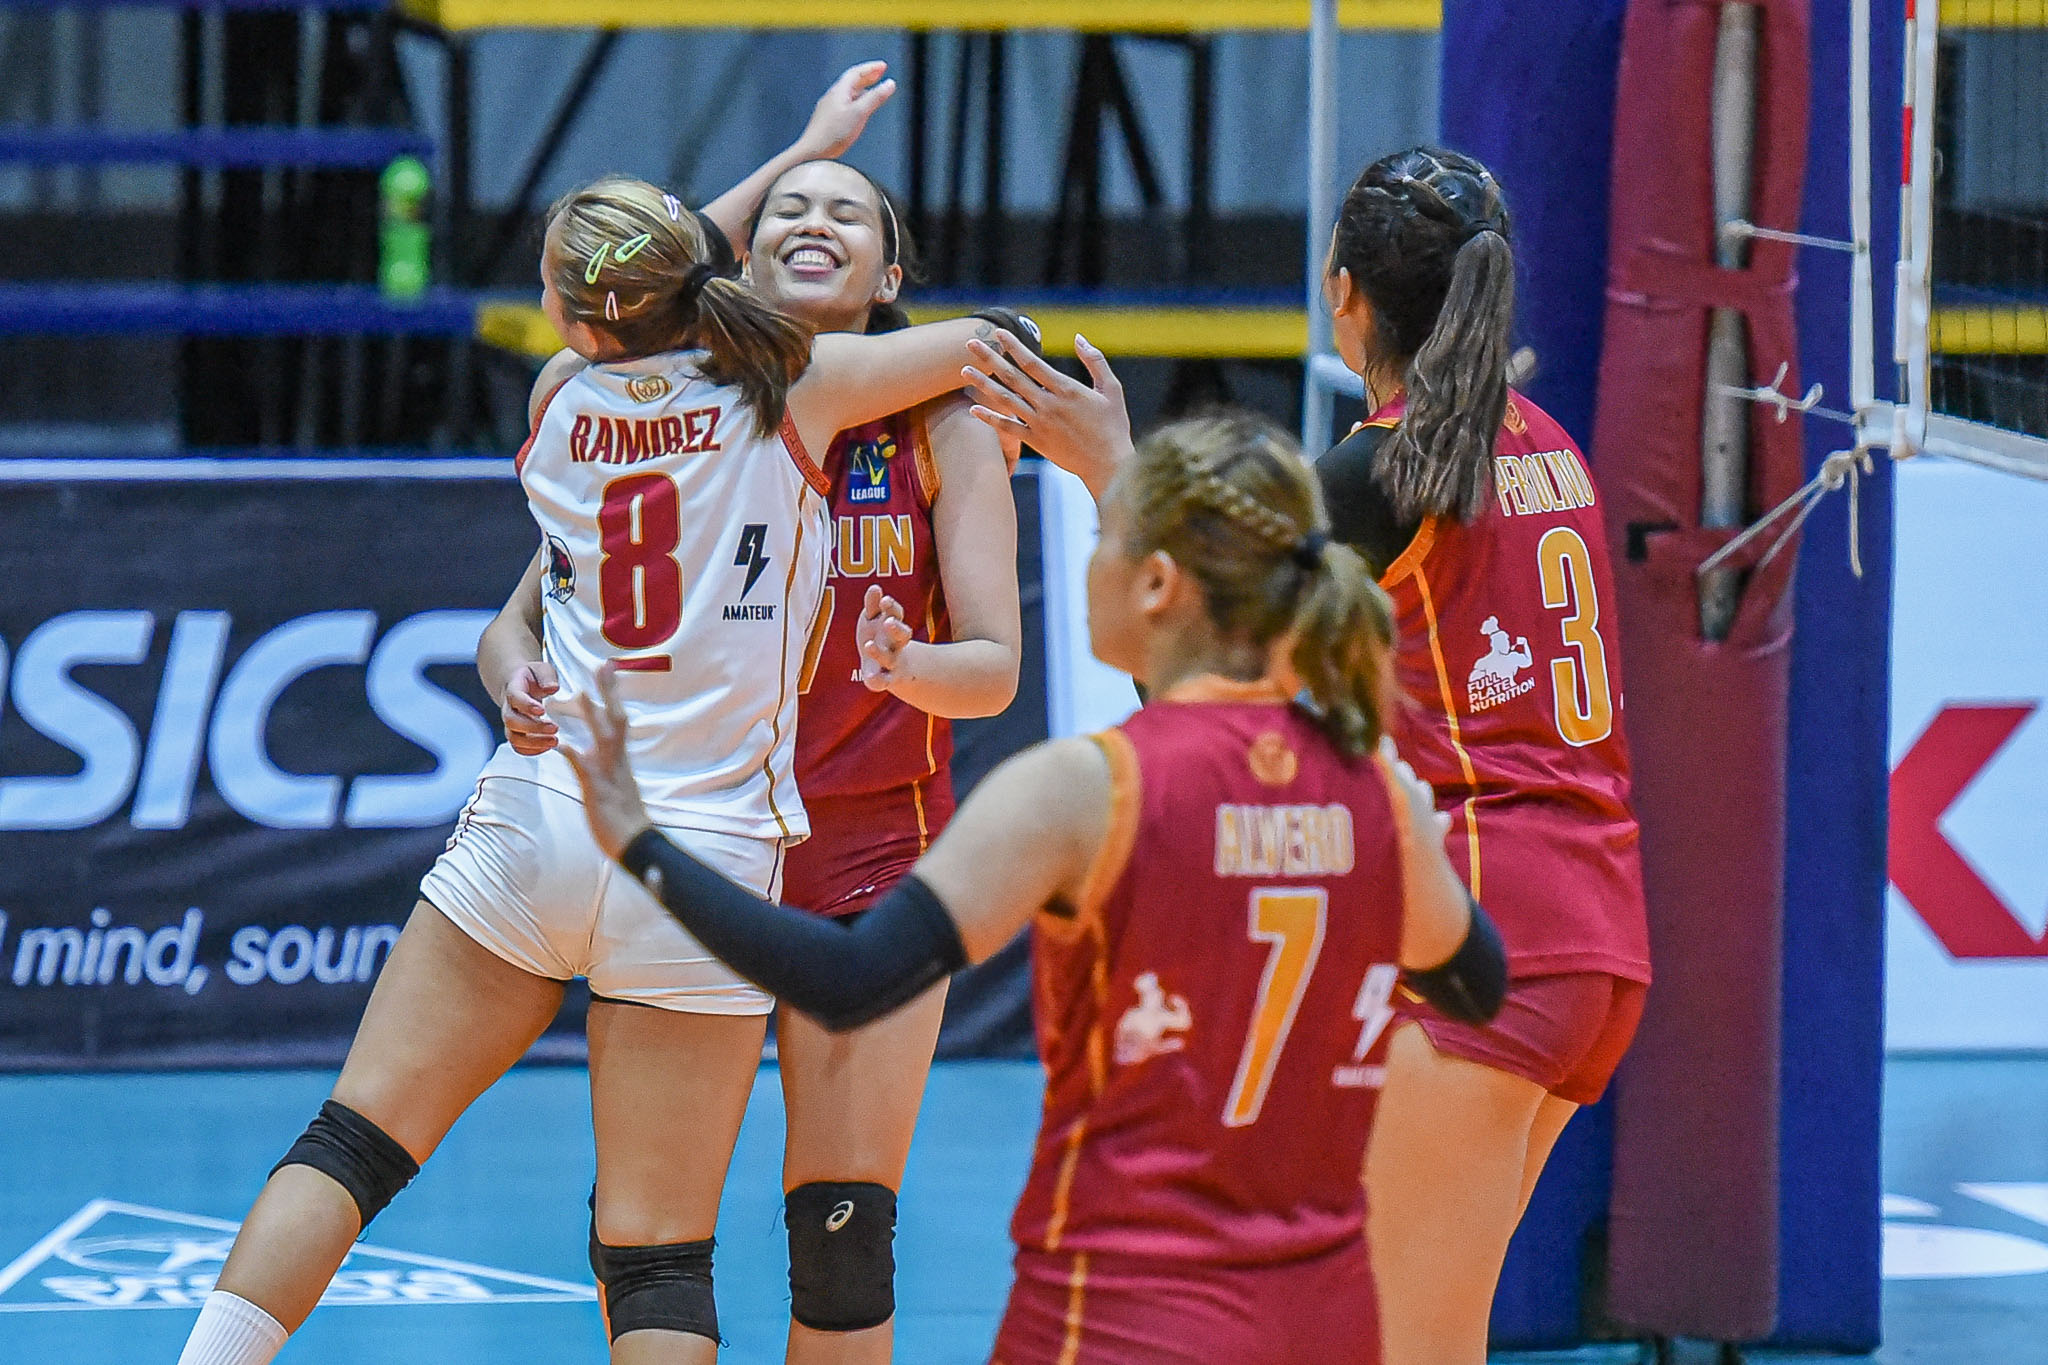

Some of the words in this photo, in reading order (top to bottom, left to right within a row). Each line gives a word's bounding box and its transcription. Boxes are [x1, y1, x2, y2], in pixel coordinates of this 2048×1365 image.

[569, 406, 722, 465] RAMIREZ
[851, 486, 886, 501] LEAGUE
[597, 471, 682, 650] 8
[722, 604, 777, 621] AMATEUR
[1537, 526, 1612, 747] 3
[1467, 671, 1501, 693] FULL
[1469, 677, 1511, 704] PLATE
[1469, 676, 1536, 713] NUTRITION
[0, 609, 500, 831] SICS
[12, 907, 208, 996] mind,
[1221, 887, 1328, 1127] 7
